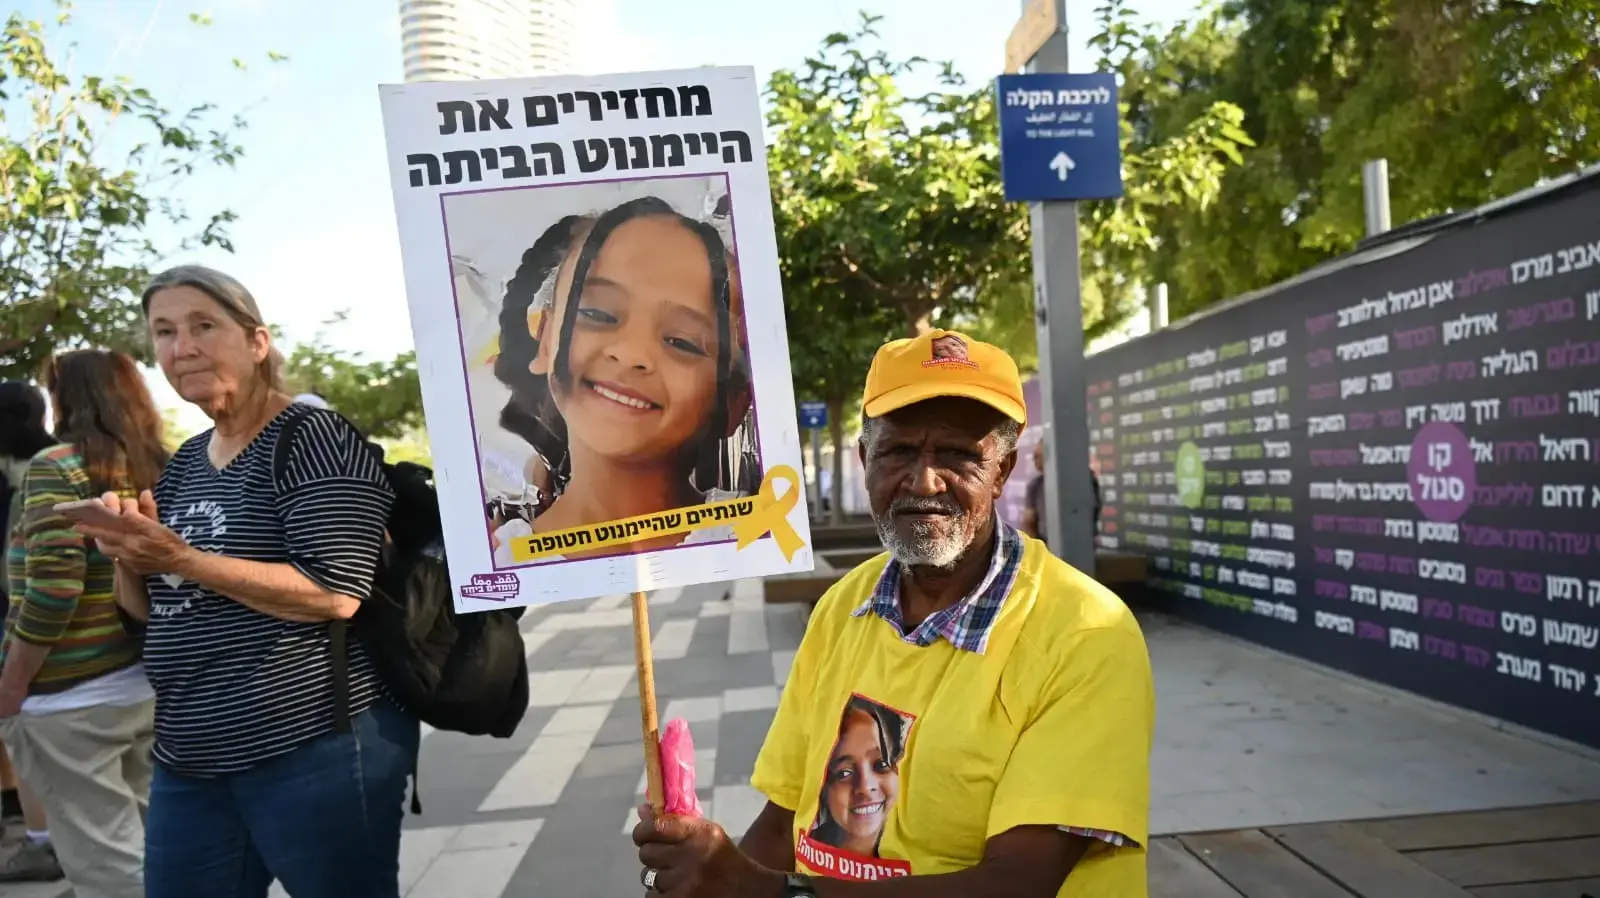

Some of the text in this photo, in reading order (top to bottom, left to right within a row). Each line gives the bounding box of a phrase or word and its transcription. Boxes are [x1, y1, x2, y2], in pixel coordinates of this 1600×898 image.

[437, 84, 712, 136] מחזירים את
[1006, 86, 1110, 110] לרכבת הקלה
[407, 130, 753, 187] היימנוט הביתה
[1428, 442, 1452, 472] קו
[1417, 473, 1464, 501] סגול
[528, 500, 753, 554] שנתיים שהיימנוט חטופה
